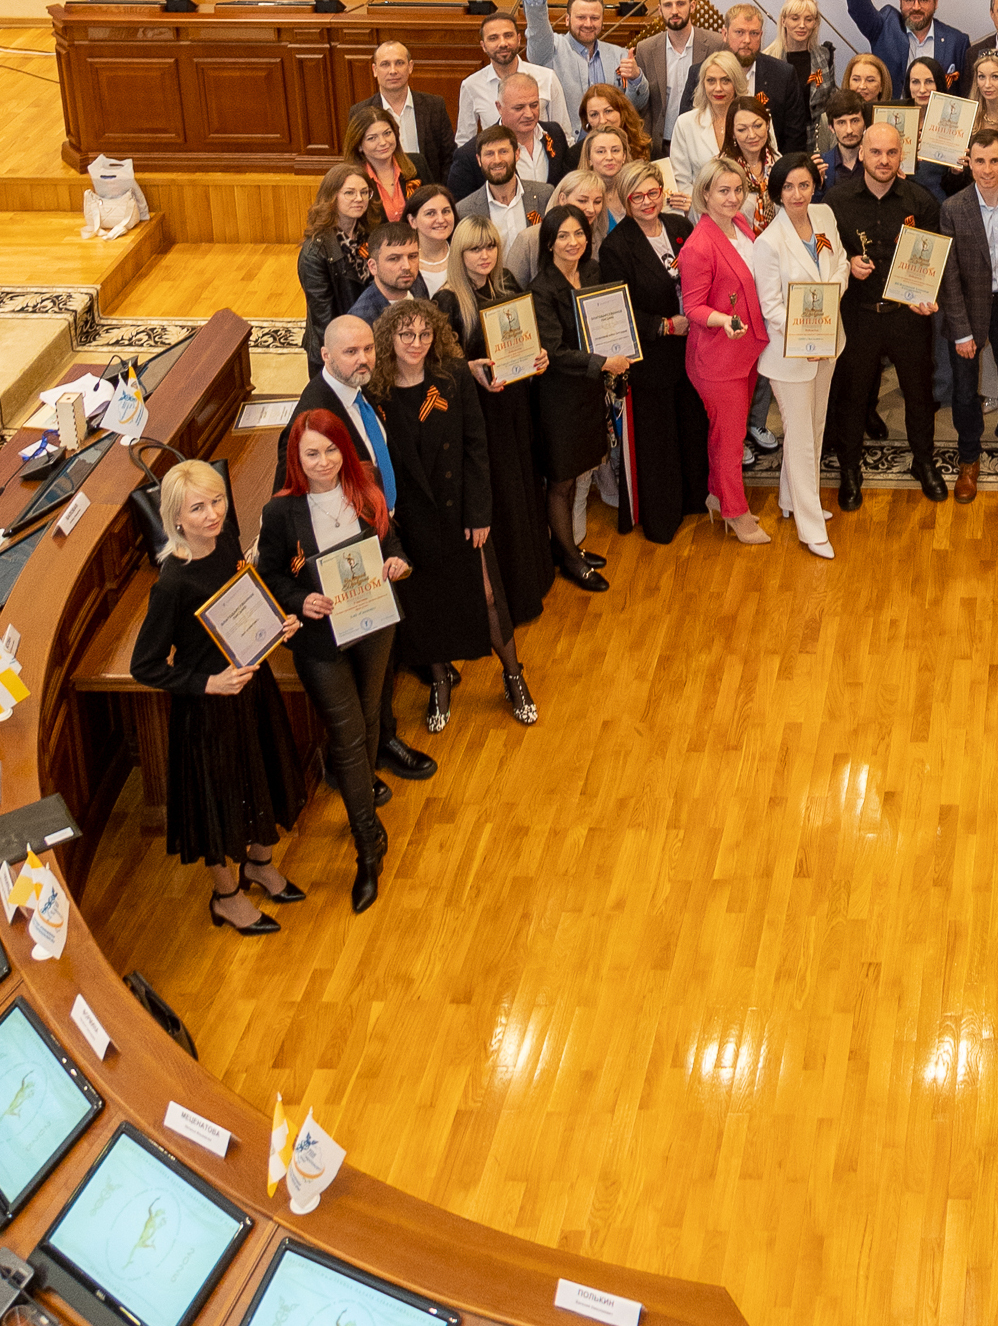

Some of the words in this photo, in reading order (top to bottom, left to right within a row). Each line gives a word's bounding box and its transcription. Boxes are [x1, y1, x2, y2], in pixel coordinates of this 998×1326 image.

[898, 262, 936, 277] ДИПЛОМ
[494, 334, 532, 353] ДИПЛОМ
[334, 579, 381, 605] ДИПЛОМ
[181, 1111, 220, 1137] МЕЦЕНАТОВА
[578, 1289, 614, 1307] ПОЛЬКИН
